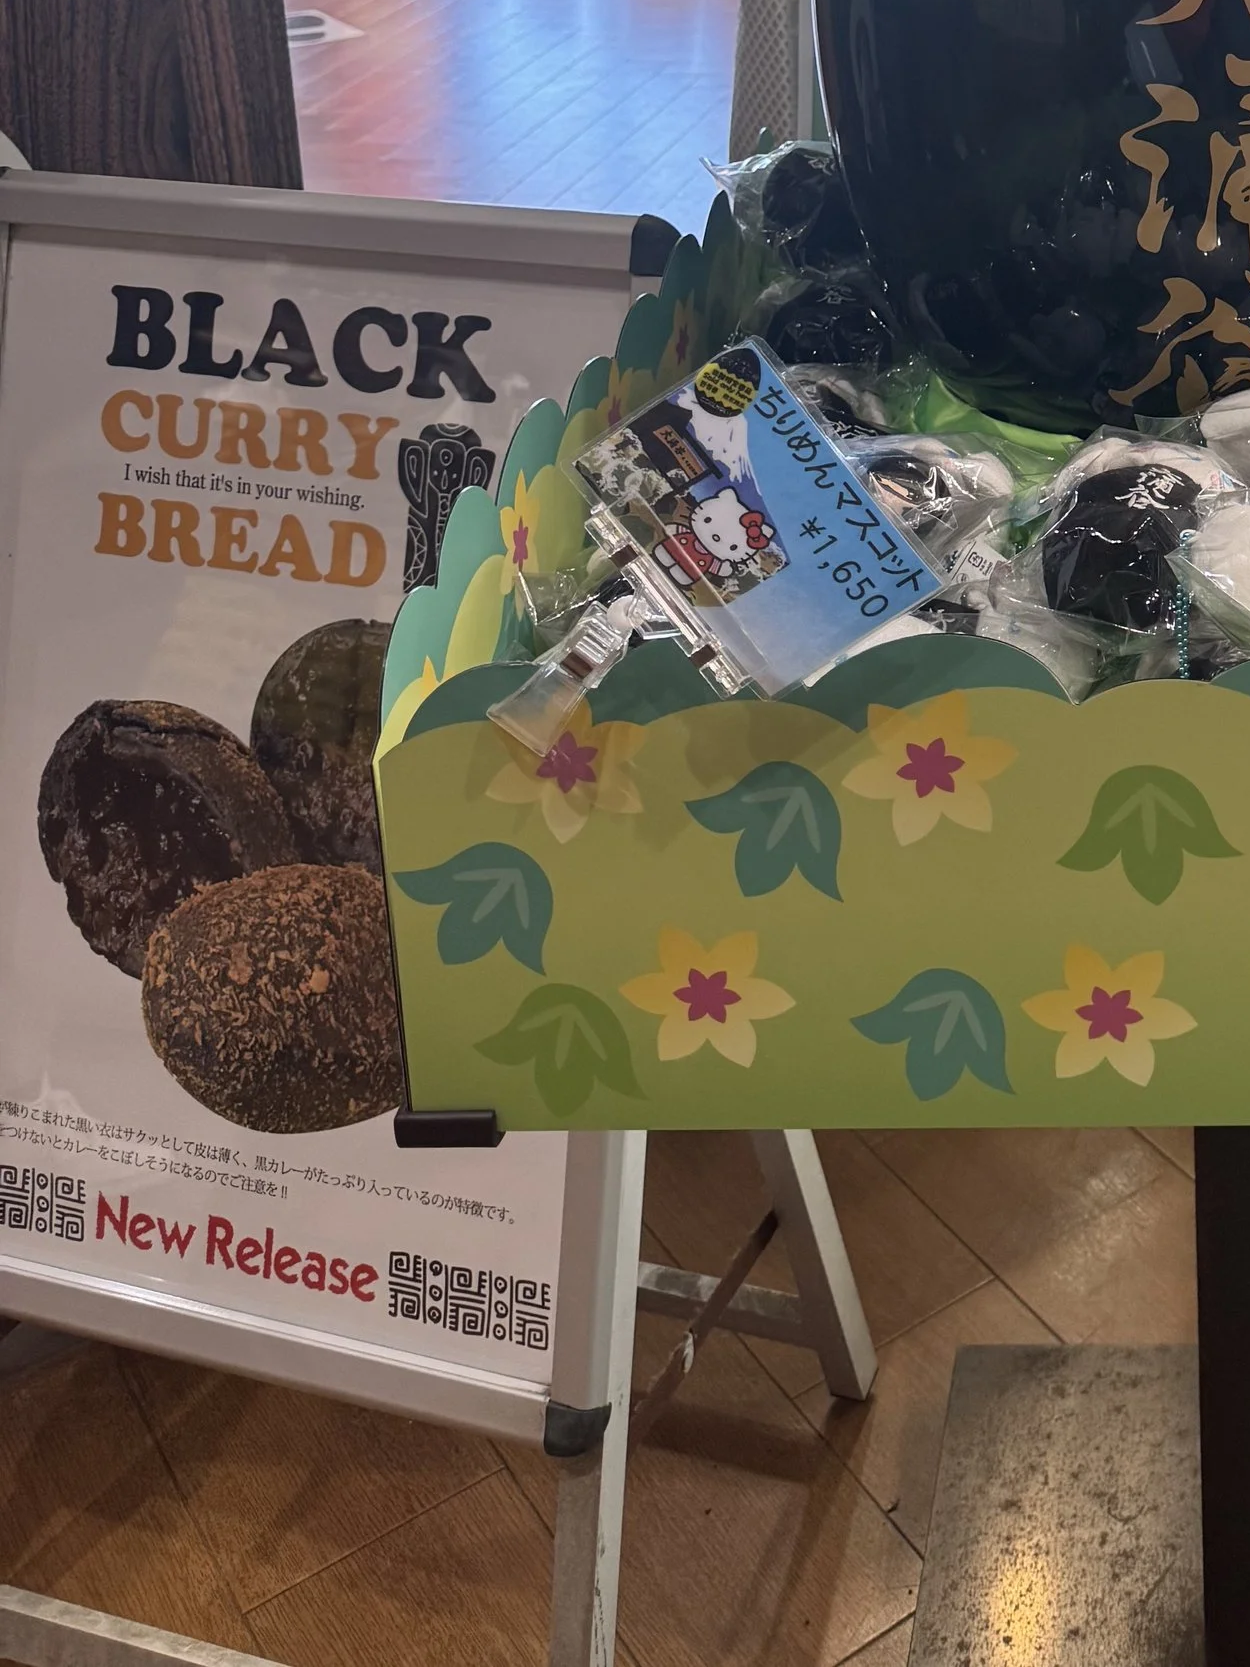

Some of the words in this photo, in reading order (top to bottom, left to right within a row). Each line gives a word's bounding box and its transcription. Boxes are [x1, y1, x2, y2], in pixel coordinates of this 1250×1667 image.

[105, 284, 497, 404] BLACK
[101, 389, 400, 481] CURRY
[124, 463, 134, 483] I
[135, 464, 171, 488] wish
[175, 468, 207, 491] that
[208, 471, 233, 495] it's
[236, 476, 252, 496] in
[255, 481, 293, 502] your
[296, 485, 366, 511] wishing.
[753, 385, 924, 592] ちりめんマスコット
[94, 491, 388, 589] BREAD
[799, 516, 889, 618] ¥1,650
[95, 1190, 197, 1258] New
[205, 1214, 379, 1302] Release
